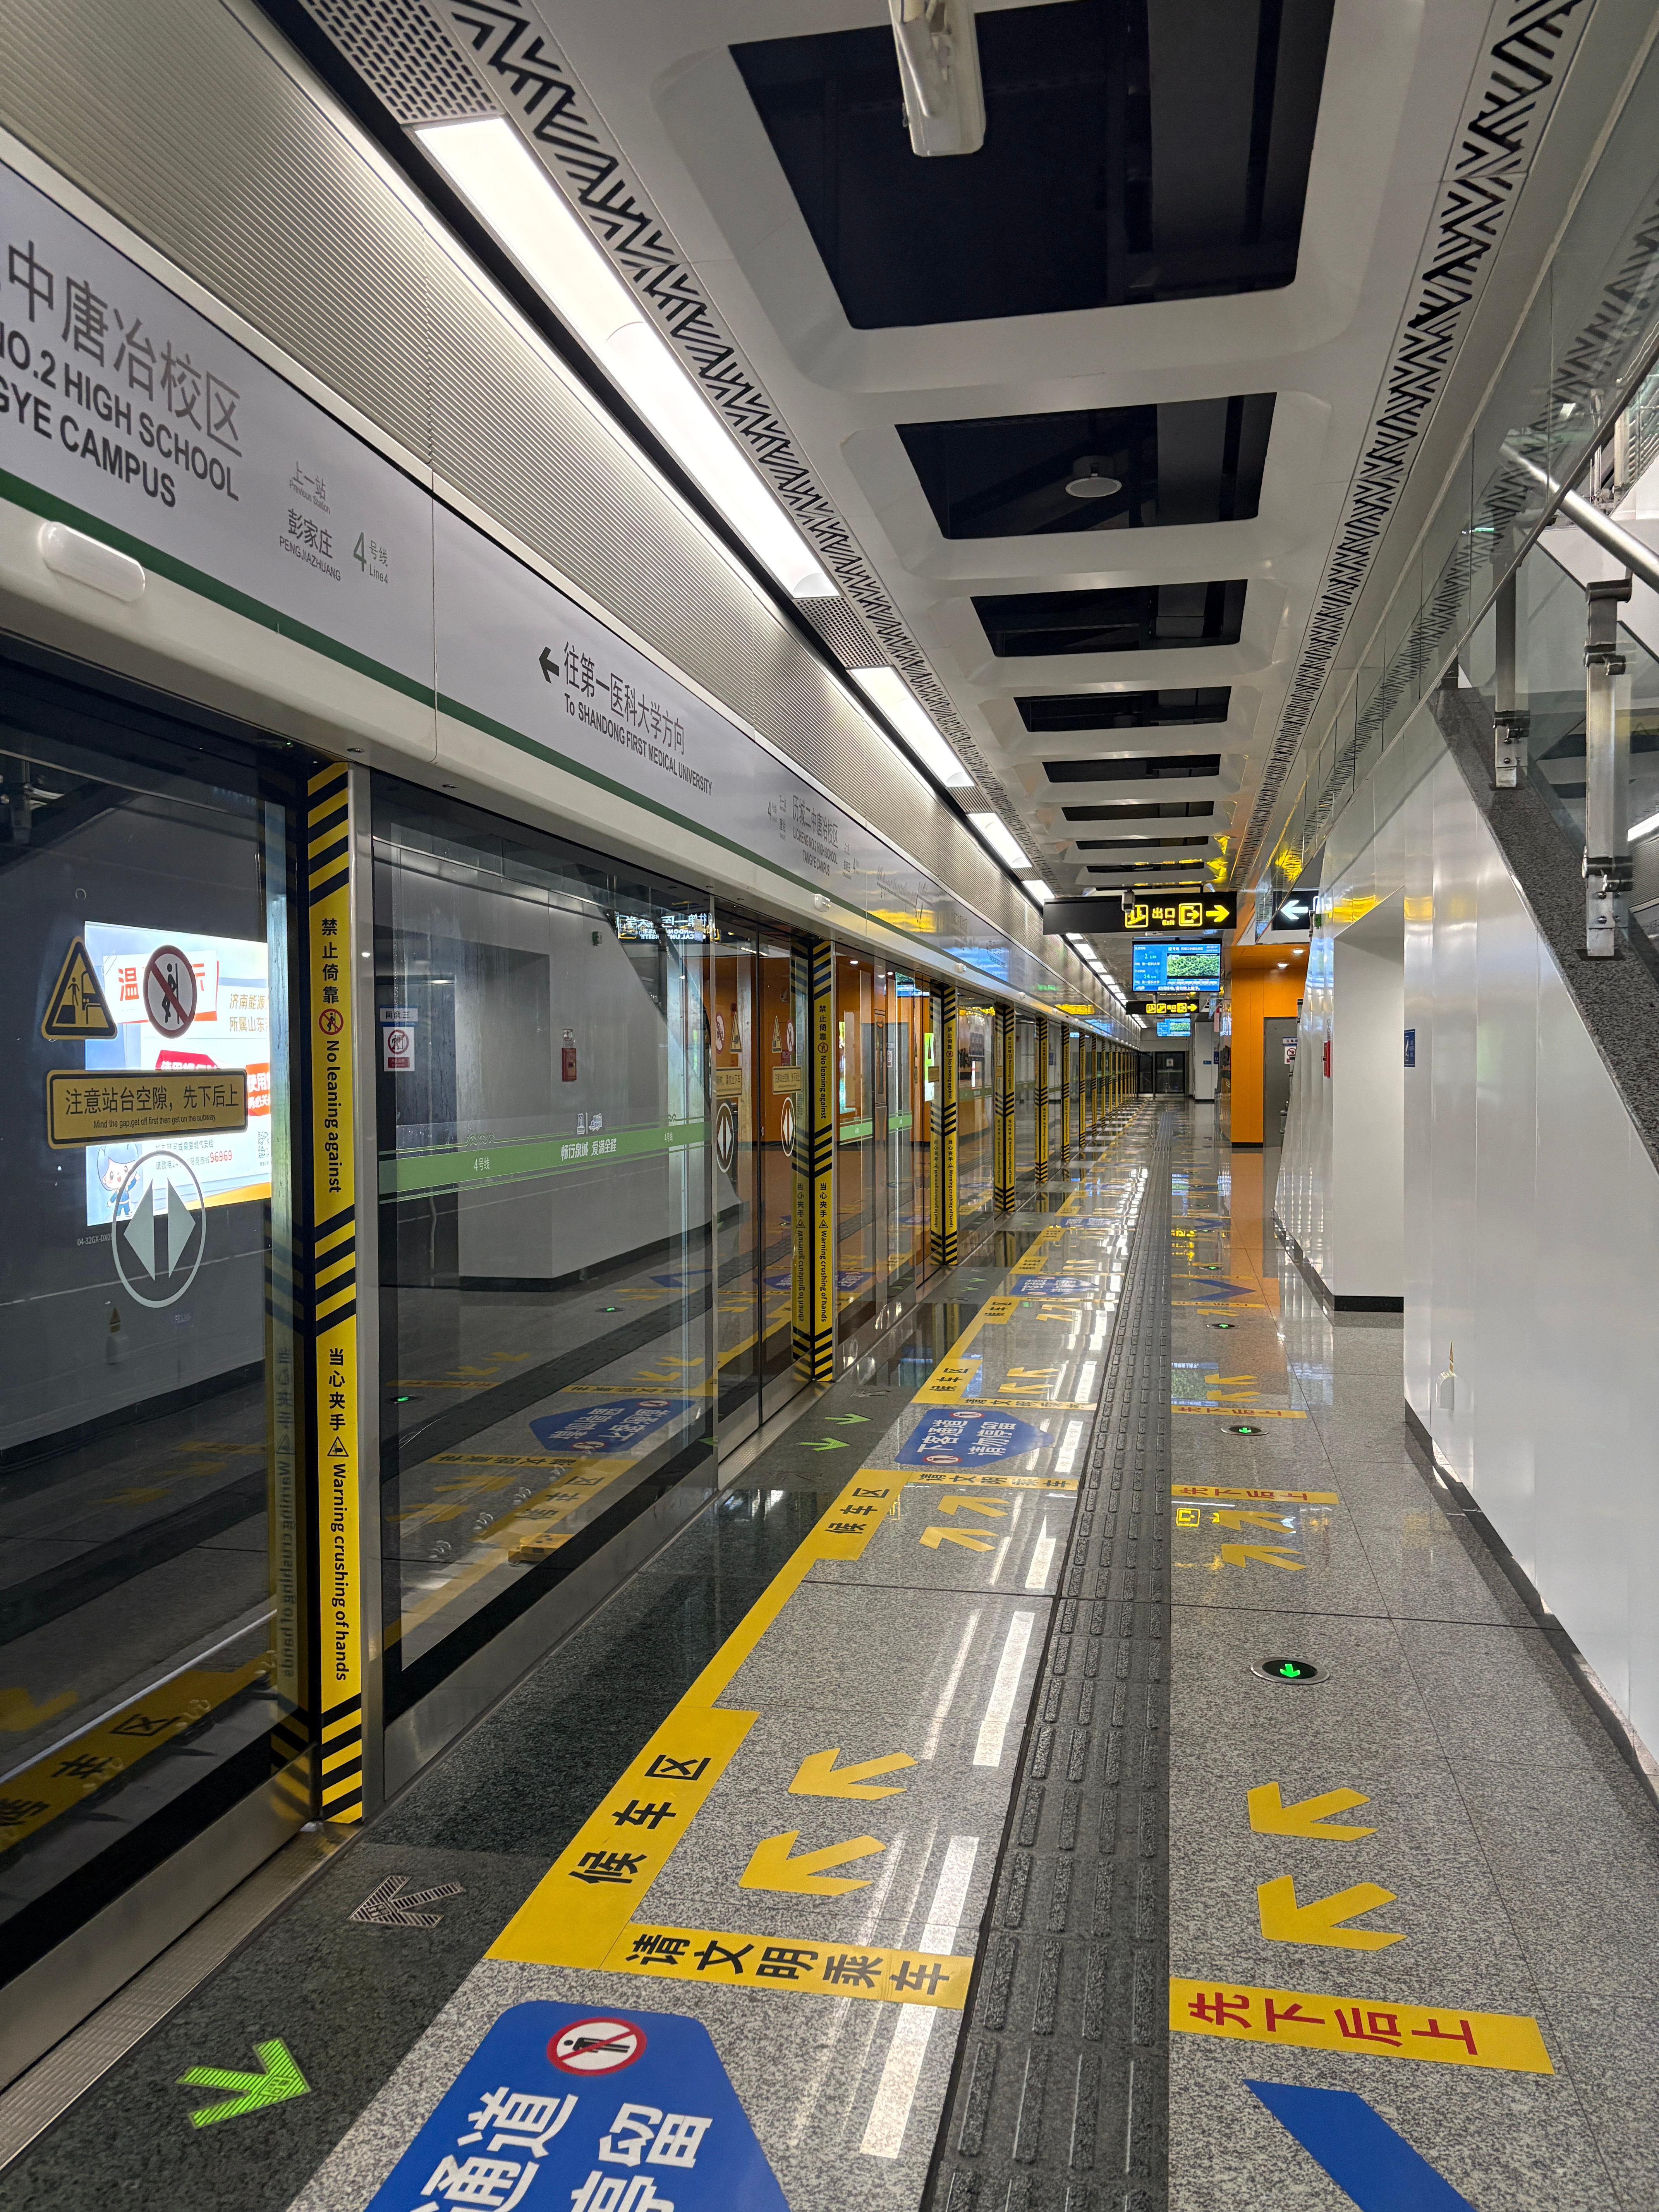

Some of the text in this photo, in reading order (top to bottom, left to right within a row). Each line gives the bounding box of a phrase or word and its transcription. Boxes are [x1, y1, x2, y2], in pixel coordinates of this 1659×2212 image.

[9, 240, 242, 457] 中唐冶校区
[64, 362, 132, 436] HIGH
[139, 411, 239, 501] SCHOOL
[60, 414, 176, 508] CAMPUS
[289, 479, 330, 514] Previous Station
[292, 461, 326, 501] 上一站
[288, 508, 333, 559] 彭家庄
[279, 536, 341, 581] PENGJIAZHUANG
[564, 641, 684, 755] 往第一医科大学方向
[564, 693, 713, 795] To SHANDONG FIRST MEDICAL UNIVERSITY
[1152, 907, 1175, 919] 出口
[321, 918, 339, 1004] 禁止倚靠
[229, 993, 269, 1010] 济南能源
[229, 1016, 269, 1033] 所属山东
[819, 1005, 827, 1041] 禁止倚靠
[65, 1085, 239, 1115] 注意站台空隙，先下后上
[819, 1055, 827, 1119] No leaning against
[94, 1120, 108, 1128] Mind
[109, 1119, 118, 1127] the
[149, 1116, 159, 1125] first
[172, 1116, 180, 1125] get
[197, 1114, 216, 1122] subway
[324, 1040, 344, 1194] No leaning against
[210, 1150, 232, 1163] 96969
[474, 1157, 490, 1171] 4号线
[819, 1182, 828, 1218] 当心夹手
[819, 1230, 827, 1259] Warning
[819, 1260, 828, 1291] crushing
[821, 1292, 828, 1301] of
[328, 1347, 346, 1432] 当心夹手
[929, 1367, 969, 1392] 候车区
[916, 1419, 968, 1453] 下客通道
[967, 1421, 1018, 1456] 请勿停留
[918, 1472, 1070, 1488] 请文明乘车
[1180, 1487, 1308, 1501] 先下后上
[824, 1487, 890, 1535] 候车区
[330, 1463, 350, 1681] Warning crushing of hands
[568, 1754, 712, 1886] 候车区
[625, 1933, 950, 1997] 请文明乘车
[1187, 1992, 1479, 2056] 先下后上
